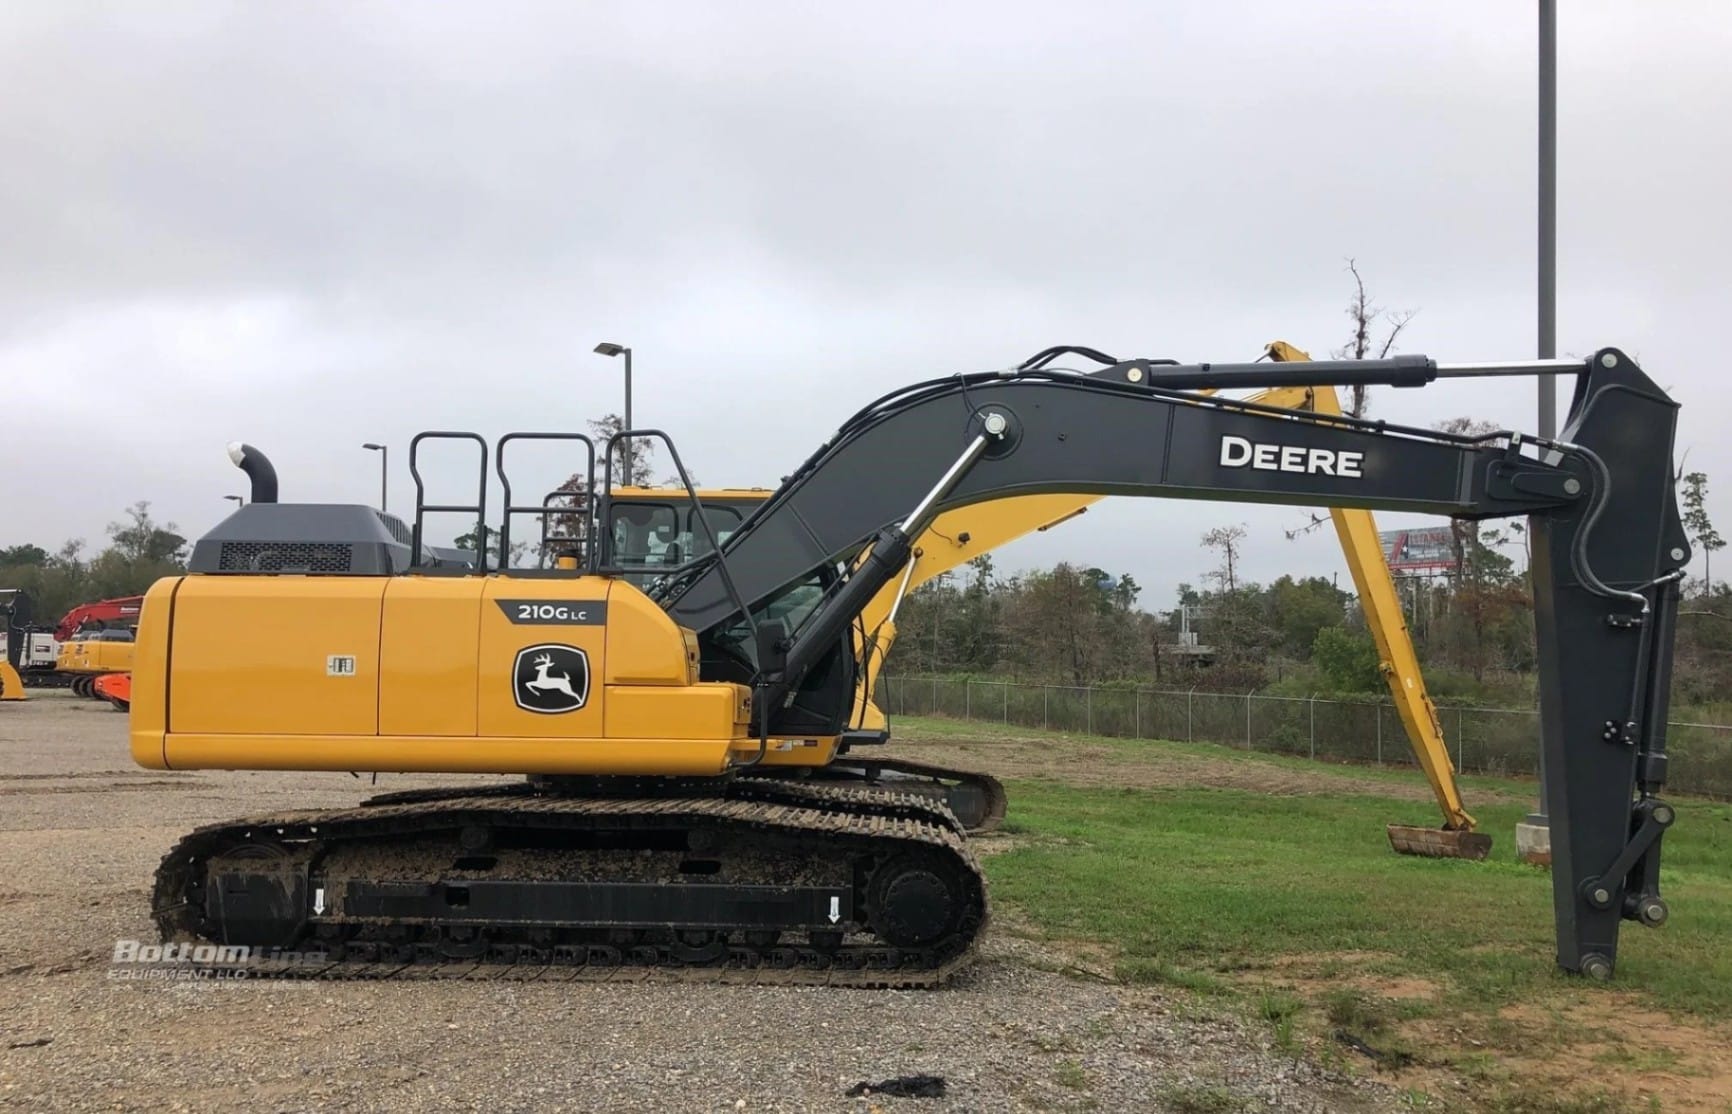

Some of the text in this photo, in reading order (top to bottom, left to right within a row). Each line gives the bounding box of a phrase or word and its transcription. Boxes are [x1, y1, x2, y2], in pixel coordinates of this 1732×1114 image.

[1220, 435, 1364, 478] DEERE
[518, 605, 587, 620] 210G LC
